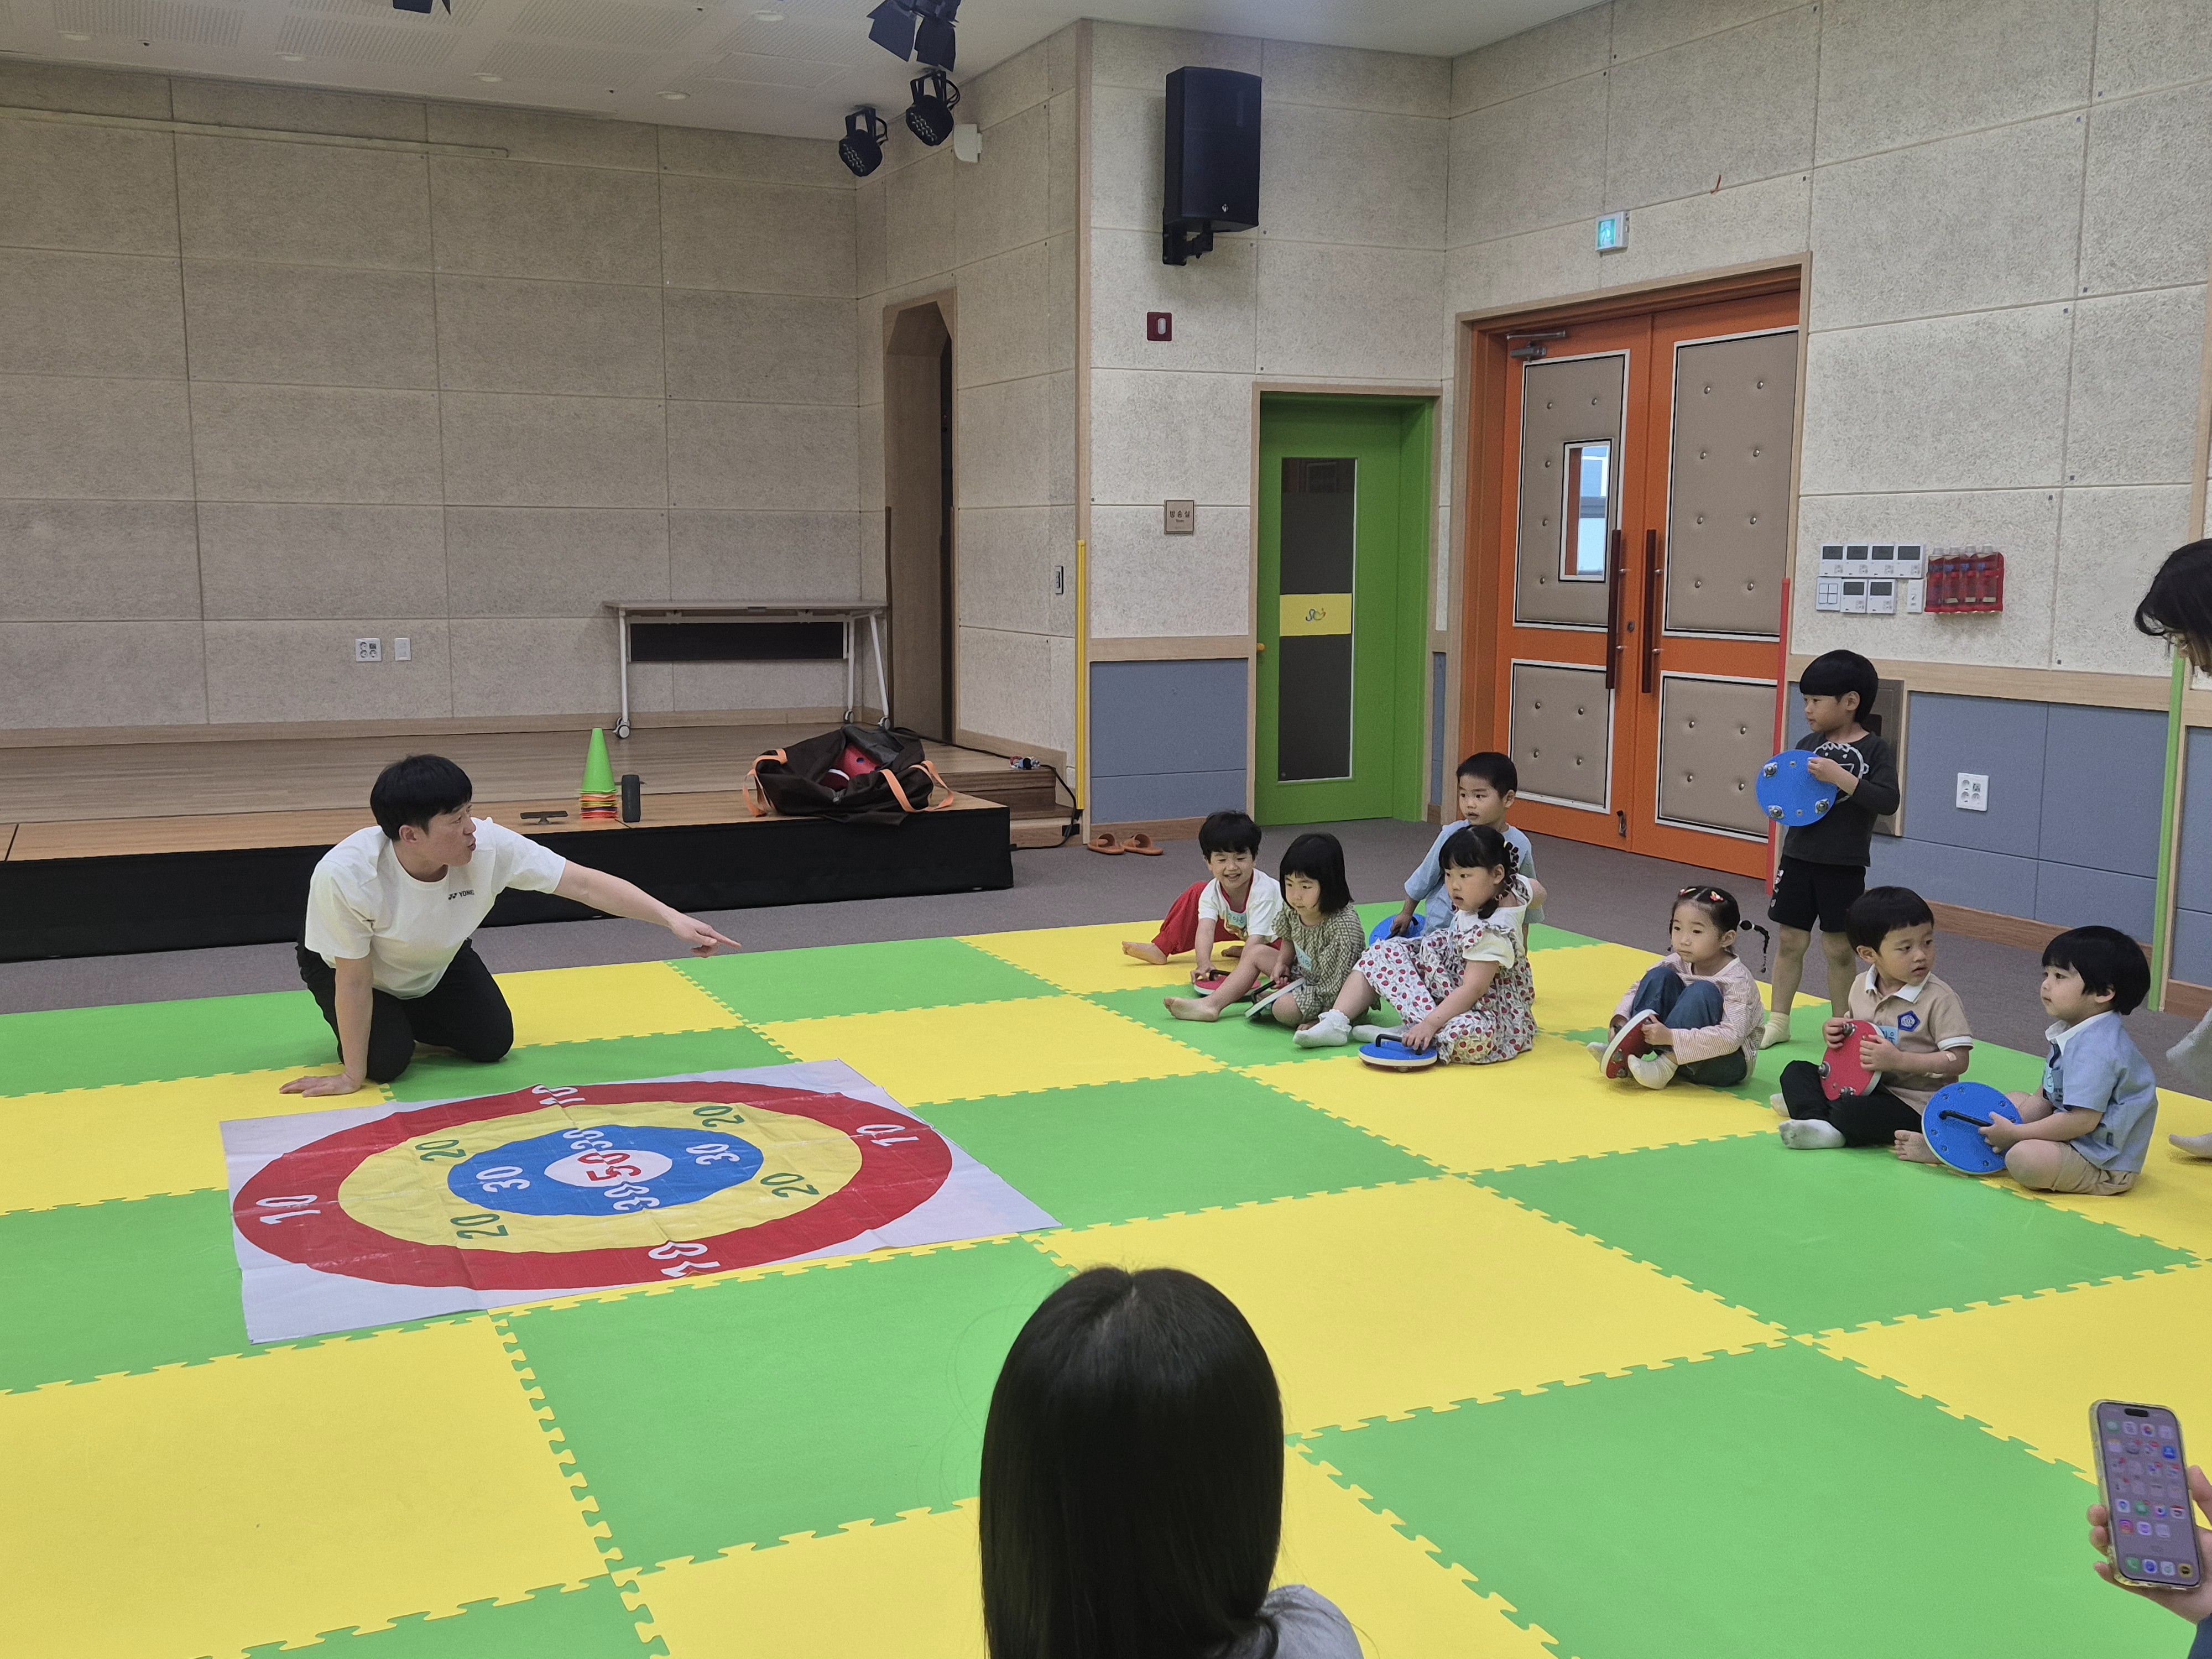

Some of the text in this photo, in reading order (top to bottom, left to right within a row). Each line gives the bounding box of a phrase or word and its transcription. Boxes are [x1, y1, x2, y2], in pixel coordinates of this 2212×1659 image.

[531, 1084, 586, 1105] 10
[693, 1105, 745, 1127] 20
[562, 1129, 613, 1150] 30
[856, 1124, 920, 1146] 10
[415, 1139, 467, 1161] 20
[686, 1143, 740, 1165] 30
[577, 1152, 641, 1181] 50
[476, 1166, 530, 1193] 30
[760, 1173, 820, 1197] 20
[604, 1182, 660, 1211] 30
[256, 1195, 321, 1225] 10
[450, 1214, 509, 1239] 20
[648, 1241, 721, 1277] 10
